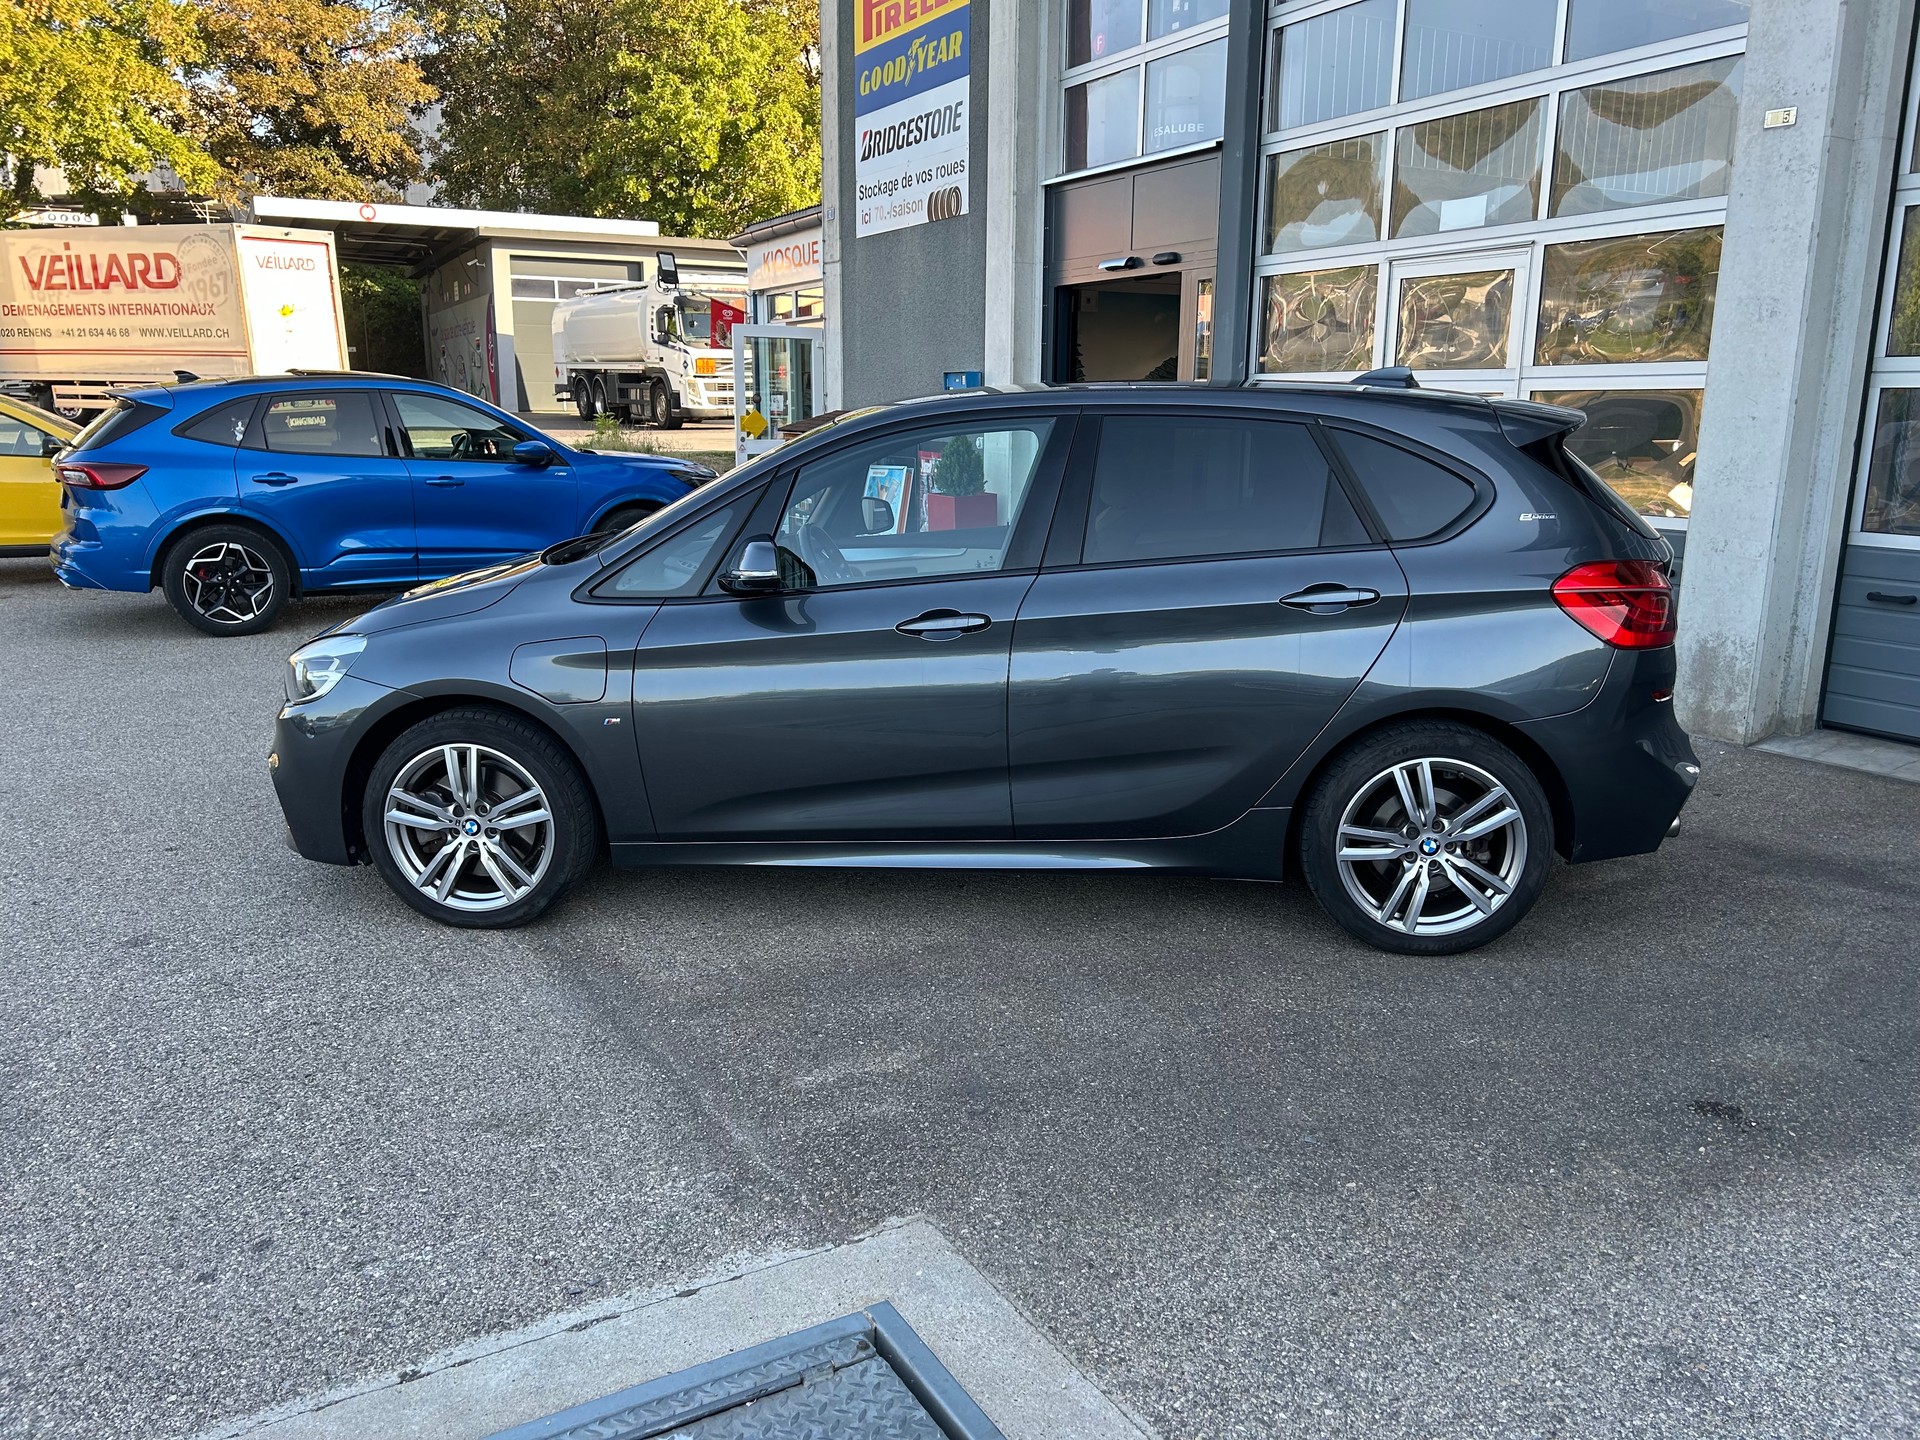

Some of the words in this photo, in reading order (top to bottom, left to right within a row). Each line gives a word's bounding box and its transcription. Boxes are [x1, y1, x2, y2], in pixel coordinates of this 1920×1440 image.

[863, 0, 957, 43] PIREL
[860, 100, 963, 162] BRIDGESTONE
[858, 178, 899, 201] Stockage
[901, 171, 913, 189] de
[915, 168, 933, 185] vos
[935, 159, 965, 180] roues
[861, 208, 871, 225] ici
[18, 242, 182, 291] VEILLARD
[187, 255, 218, 274] Fondée
[255, 252, 316, 271] VEILLARD
[763, 240, 820, 273] KIOSQUE
[187, 271, 228, 304] 1967
[2, 304, 106, 317] DEMENAGEMENTS
[108, 303, 216, 316] INTERNATIONAUX
[0, 328, 15, 338] 020
[17, 328, 52, 338] RENENS
[61, 328, 75, 337] +41
[77, 328, 86, 337] 21
[88, 328, 104, 337] 634
[106, 328, 117, 337] 46
[119, 328, 130, 338] 68
[139, 328, 230, 338] WWW.VEILLARD.CH
